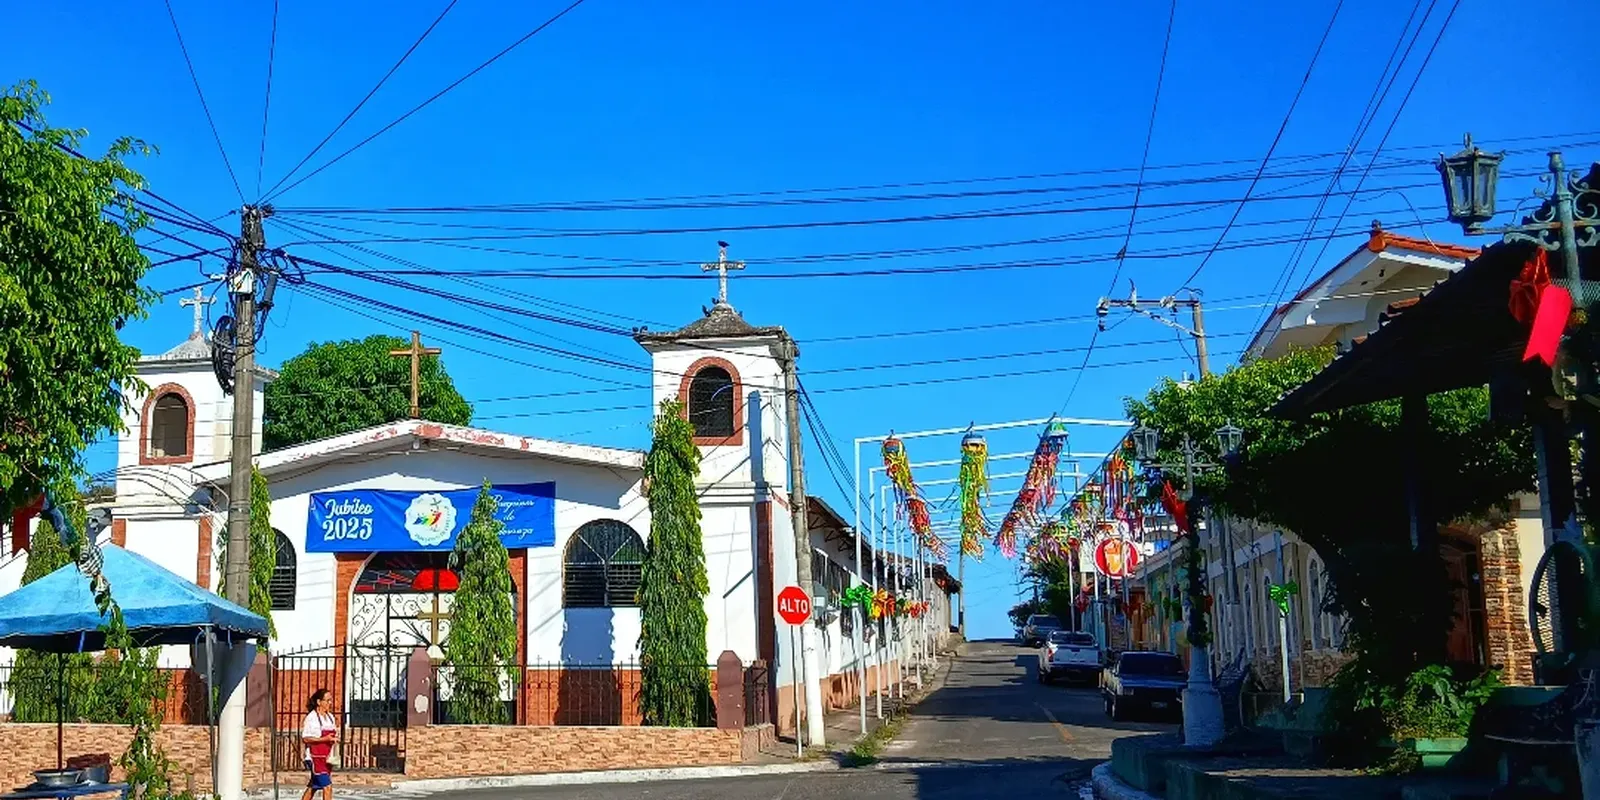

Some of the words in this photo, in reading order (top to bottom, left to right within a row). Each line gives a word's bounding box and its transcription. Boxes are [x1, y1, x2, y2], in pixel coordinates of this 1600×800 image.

[325, 498, 374, 519] Jubileo
[322, 517, 373, 541] 2025
[780, 598, 808, 614] ALTO
